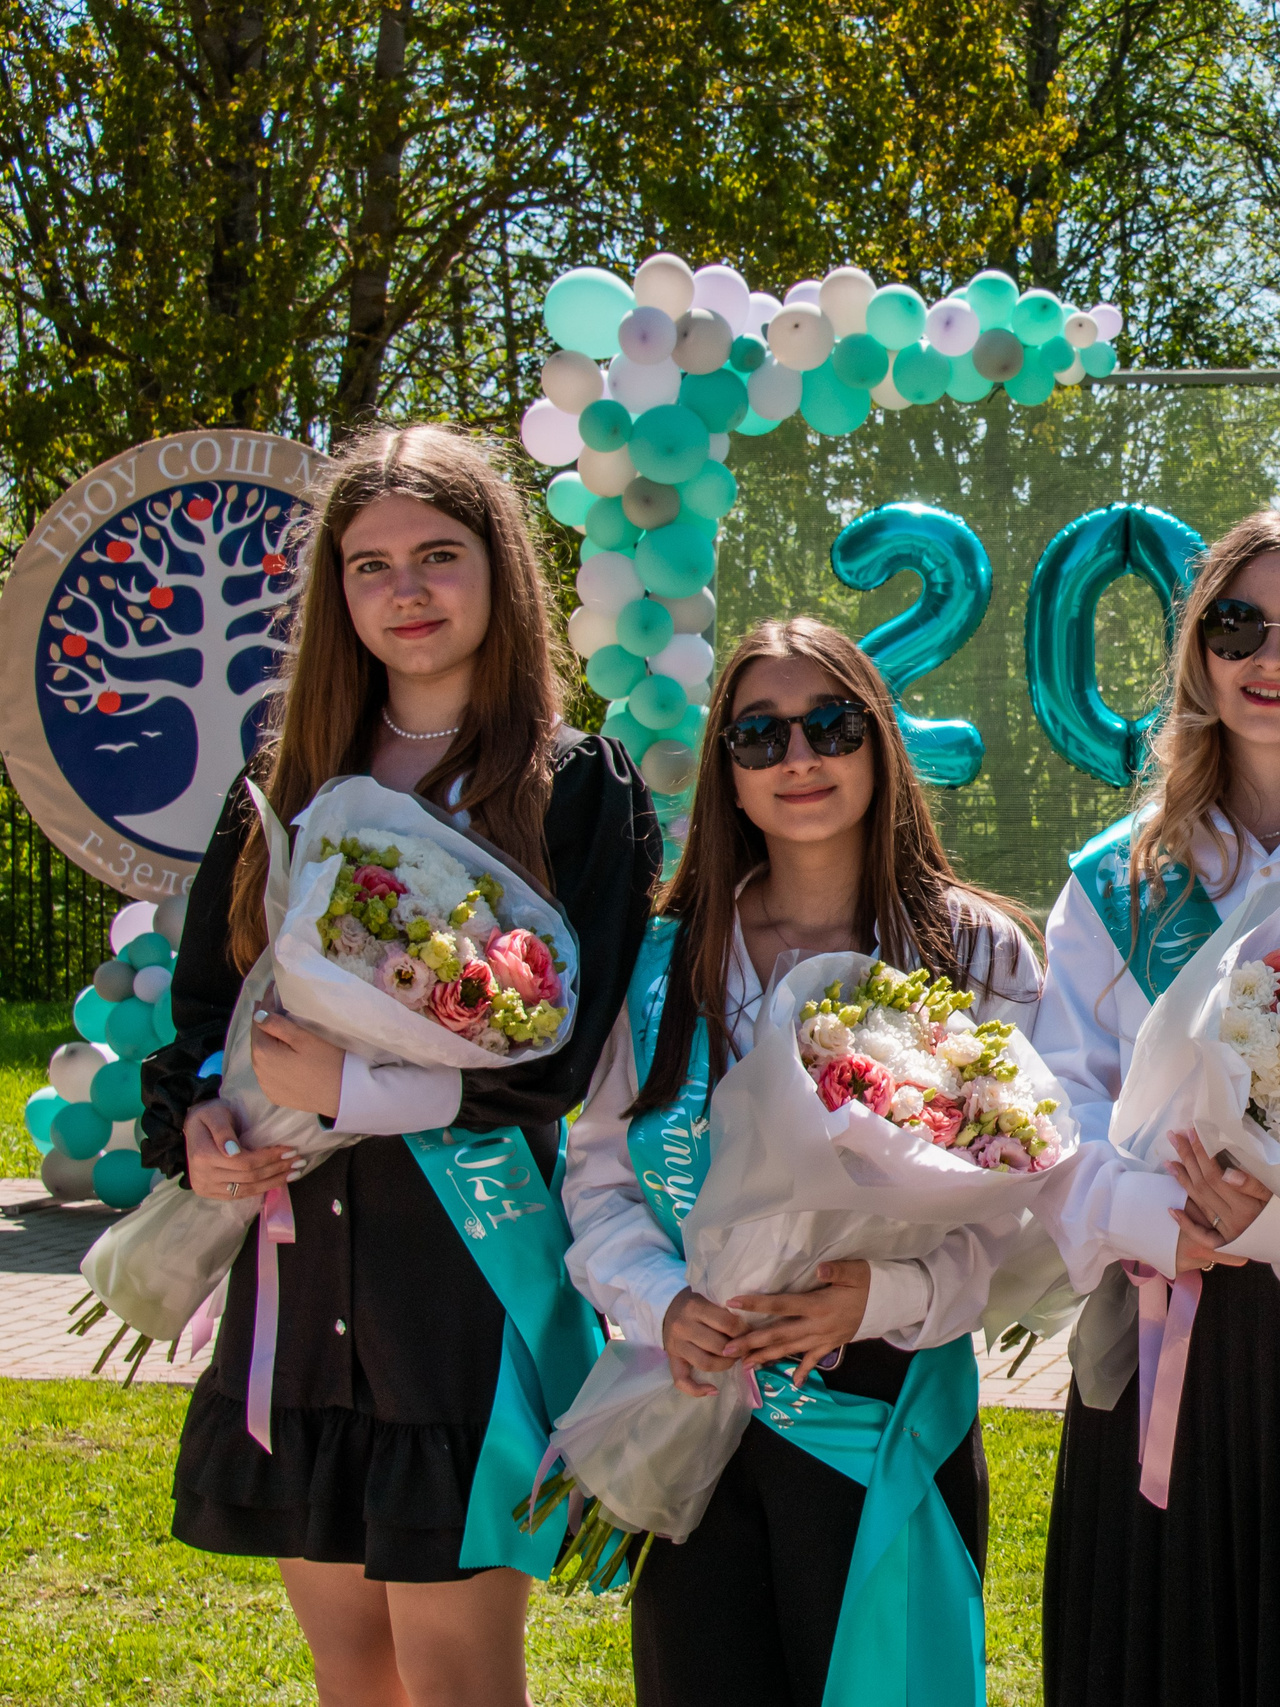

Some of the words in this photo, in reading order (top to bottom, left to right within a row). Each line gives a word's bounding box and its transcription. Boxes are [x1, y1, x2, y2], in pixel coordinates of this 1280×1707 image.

[34, 455, 138, 564] ГБОУ
[157, 436, 278, 480] СОШ
[79, 830, 197, 896] г.Зеле
[443, 1127, 546, 1230] 024
